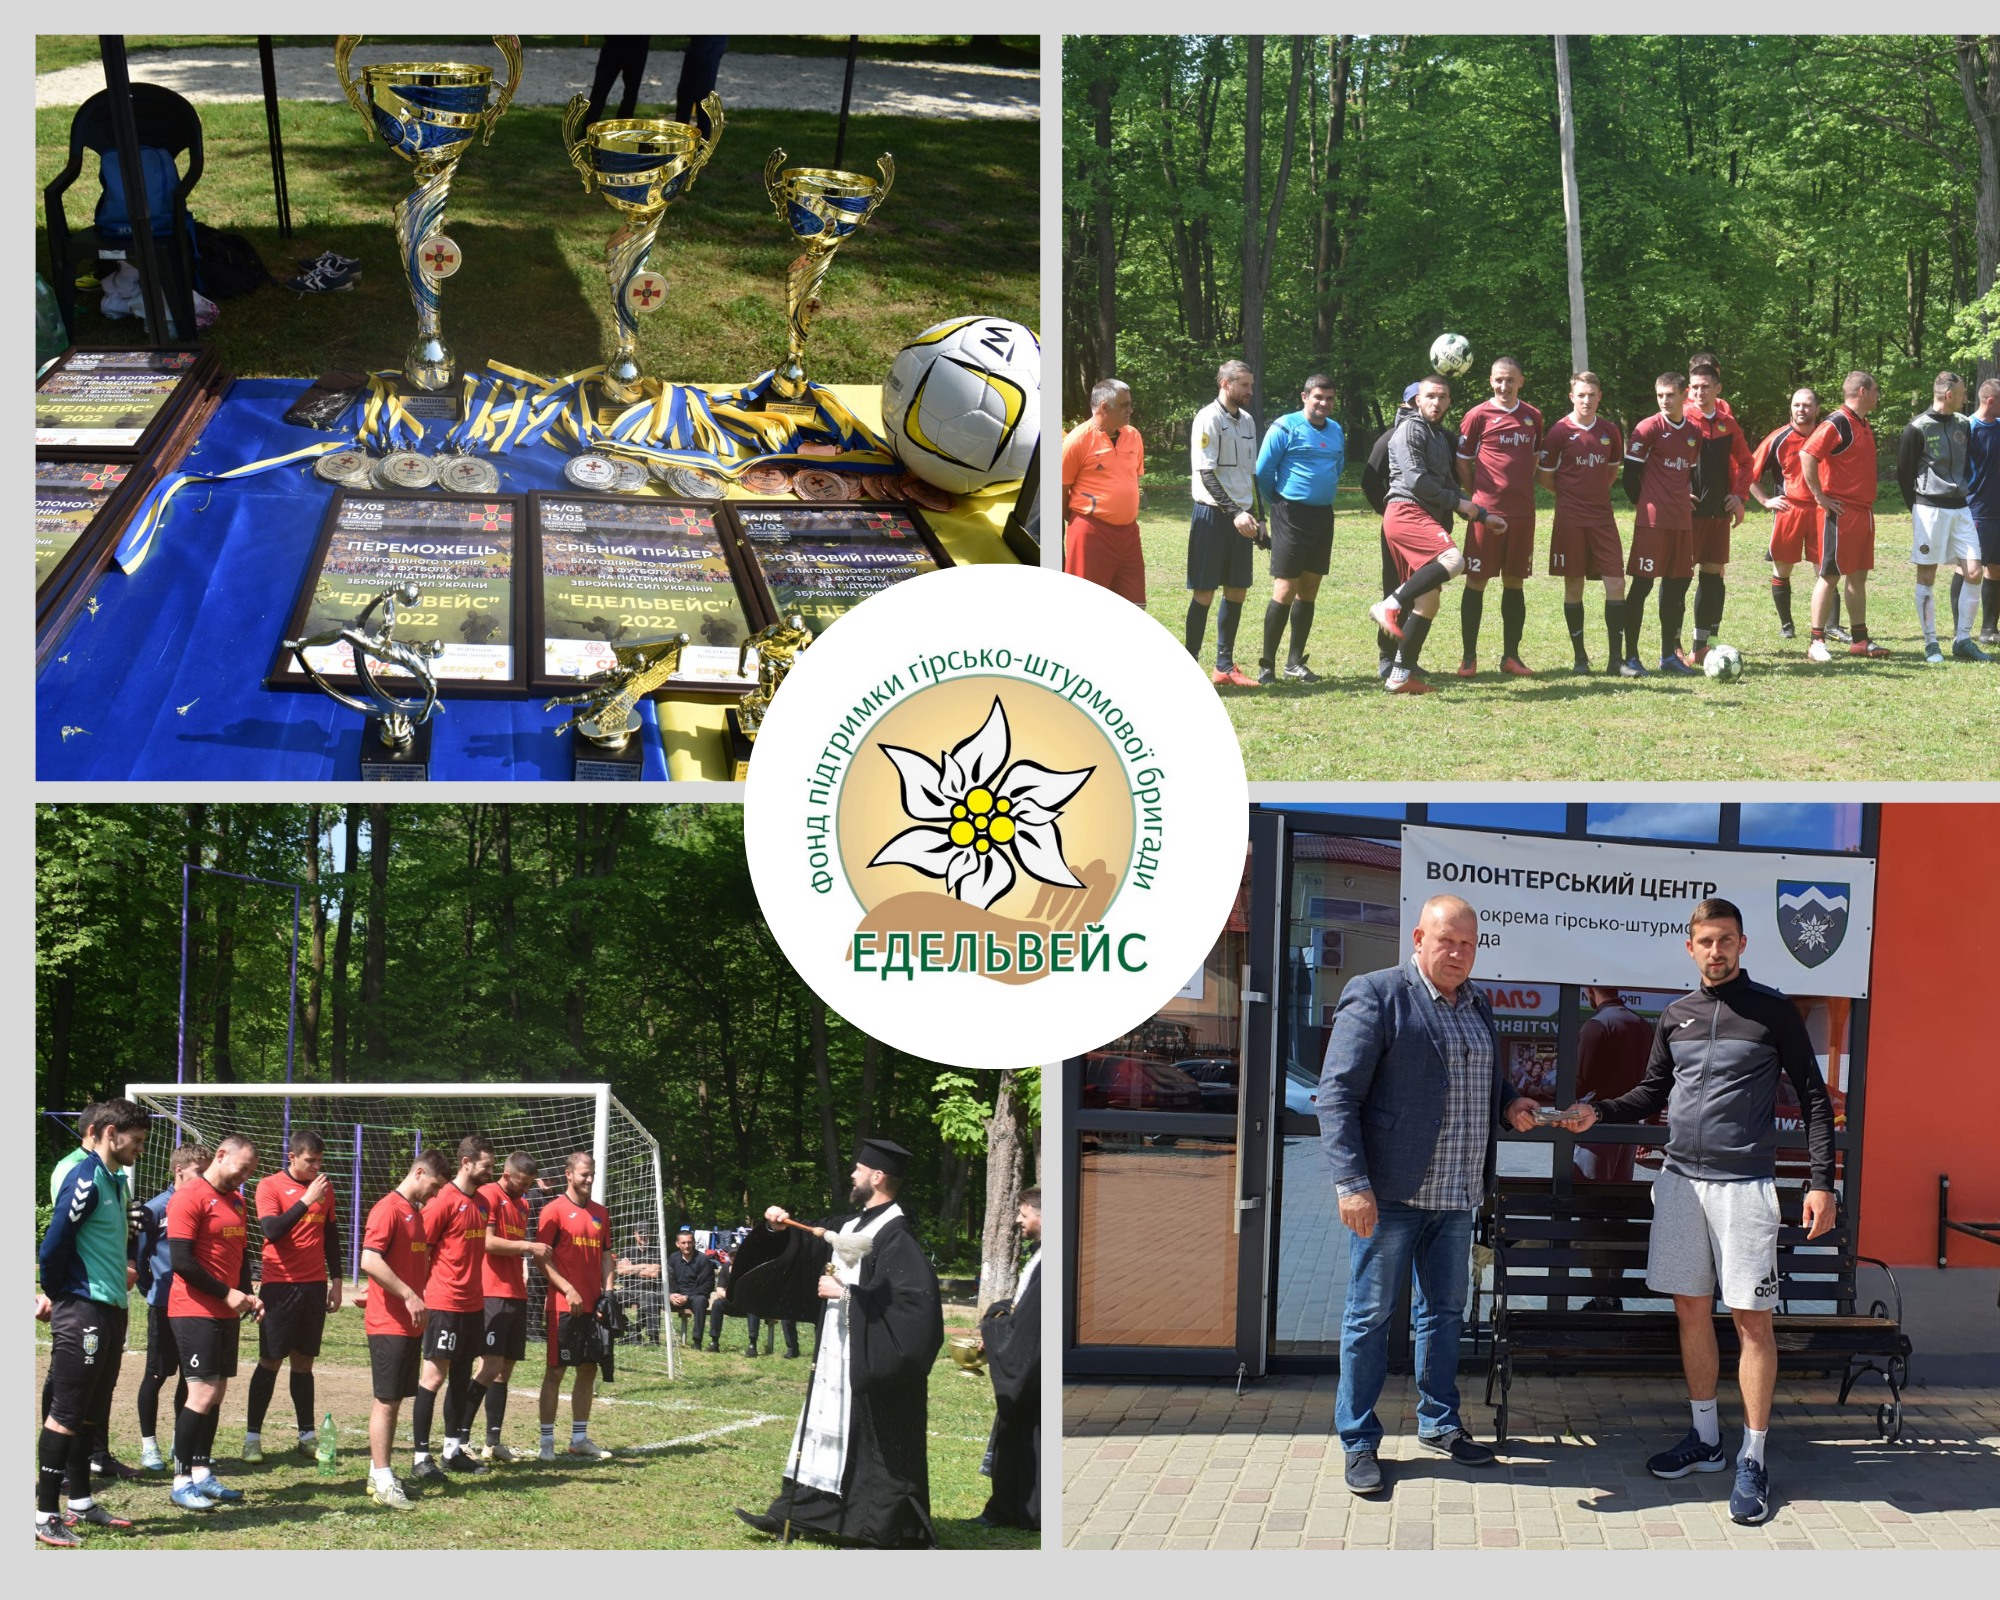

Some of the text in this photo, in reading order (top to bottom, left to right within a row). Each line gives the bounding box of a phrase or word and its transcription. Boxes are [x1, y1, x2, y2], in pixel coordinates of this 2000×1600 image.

[36, 500, 98, 509] ОПОМОГУ
[348, 502, 386, 512] 14/05
[544, 504, 583, 512] 14/05
[346, 511, 383, 520] 15/05
[547, 513, 583, 522] 15/05
[741, 513, 782, 522] 14/05
[747, 522, 786, 531] 15/05
[1437, 531, 1450, 543] 7
[347, 541, 498, 556] ПЕРЕМОЖЕЦЬ
[555, 542, 714, 560] СРІБНИЙ ПРИЗЕР
[354, 556, 488, 567] БЛАГОДІЙНОГО ТУРНІРУ
[764, 553, 926, 563] БРОНЗОВИЙ ПРИЗЕР
[1554, 554, 1565, 567] 11
[570, 557, 705, 570] БЛАГОДІЙНОГО ТУРНІРУ
[1639, 557, 1654, 572] 13
[398, 565, 450, 573] ФУТБОЛУ
[617, 567, 671, 576] ФУТБОЛУ
[786, 567, 917, 575] БЛАГОДІЙНОГО ТУРНІРУ
[394, 572, 461, 580] ПІДТРИМКУ
[617, 575, 683, 584] ПІДТРИМКУ
[438, 580, 488, 589] УКРАЇНИ
[570, 579, 713, 593] ЗБРОЙНИХ СИЛ УКРАЇНИ
[794, 590, 858, 598] ЗБРОЙНИХ
[329, 591, 500, 609] “ЕДВЕЙС”
[396, 612, 439, 626] 022
[619, 614, 678, 629] 2022
[341, 659, 391, 669] САН
[1426, 861, 1717, 901] ВОЛОНТЕРСЬКИЙ ЦЕНТР
[1480, 909, 1549, 926] окрема
[437, 1330, 457, 1351] 20
[486, 1332, 495, 1346] 6
[190, 1354, 200, 1368] 6
